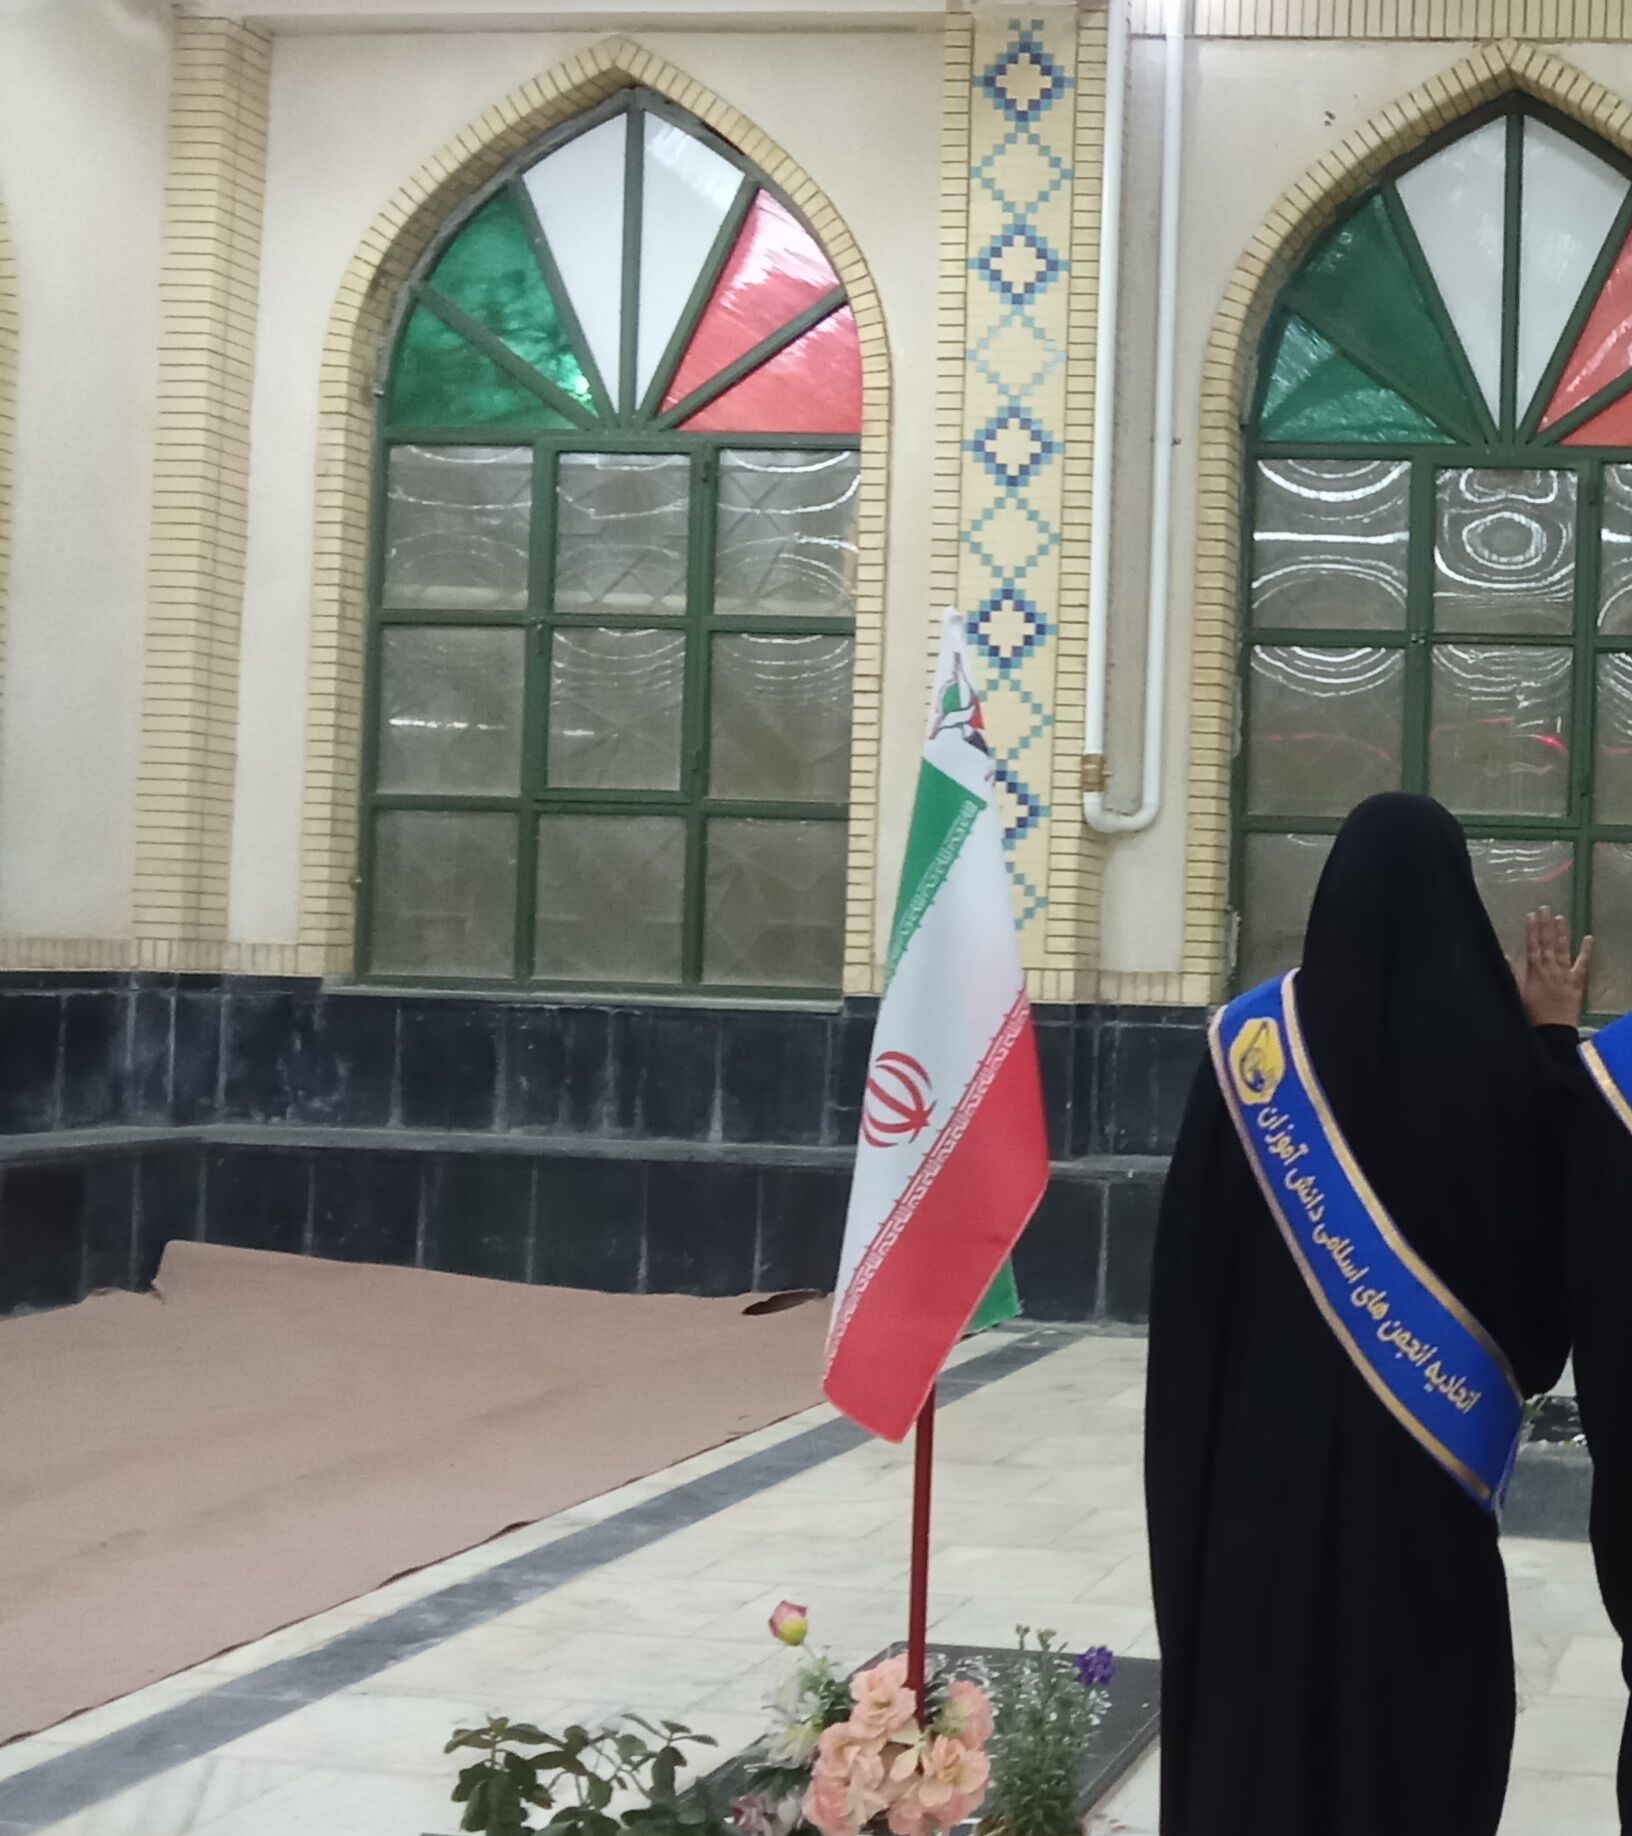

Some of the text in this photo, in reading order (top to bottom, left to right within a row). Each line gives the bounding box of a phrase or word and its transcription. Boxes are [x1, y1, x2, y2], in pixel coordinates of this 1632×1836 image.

[1257, 1106, 1481, 1414] اتحادیه انجمن های اسلامی دانش آموزان
